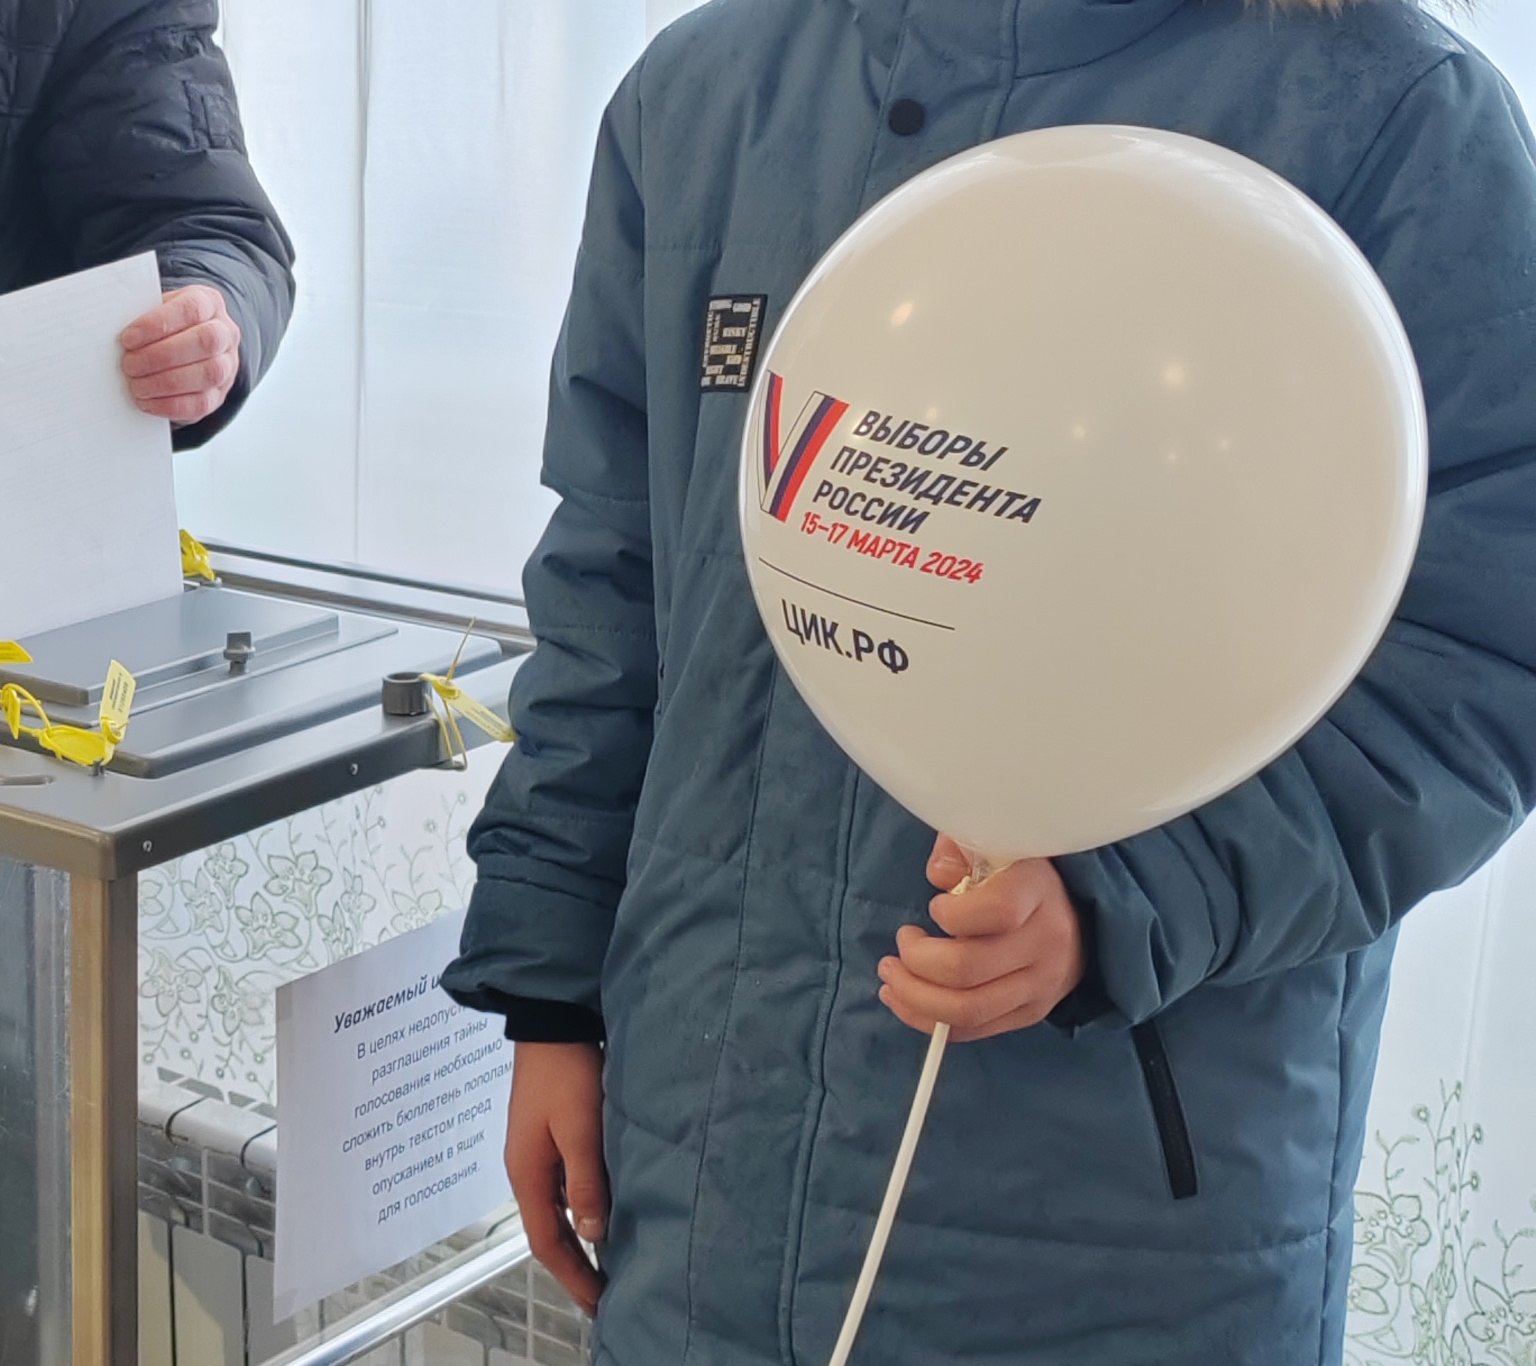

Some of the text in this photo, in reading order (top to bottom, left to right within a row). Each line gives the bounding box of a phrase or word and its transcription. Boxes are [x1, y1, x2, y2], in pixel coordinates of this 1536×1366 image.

[852, 410, 1009, 472] ВЫБОРЫ
[811, 480, 930, 534] РОССИИ
[830, 445, 1042, 524] ПРЕЗИДЕНТА
[847, 532, 920, 569] МАРТА
[920, 552, 984, 584] 2024
[781, 598, 910, 674] ЦИК.РФ
[334, 974, 428, 1034] Уважаемый
[357, 1004, 465, 1060] В целях недопус
[354, 1038, 504, 1119] голосования необходимо
[371, 1018, 488, 1086] разглашения тайны
[342, 1060, 513, 1154] сложить бюллетень пополам
[364, 1097, 493, 1172] внутрь текстом перед
[372, 1129, 486, 1196] опусканием в ящик
[377, 1160, 481, 1225] для голосования.
